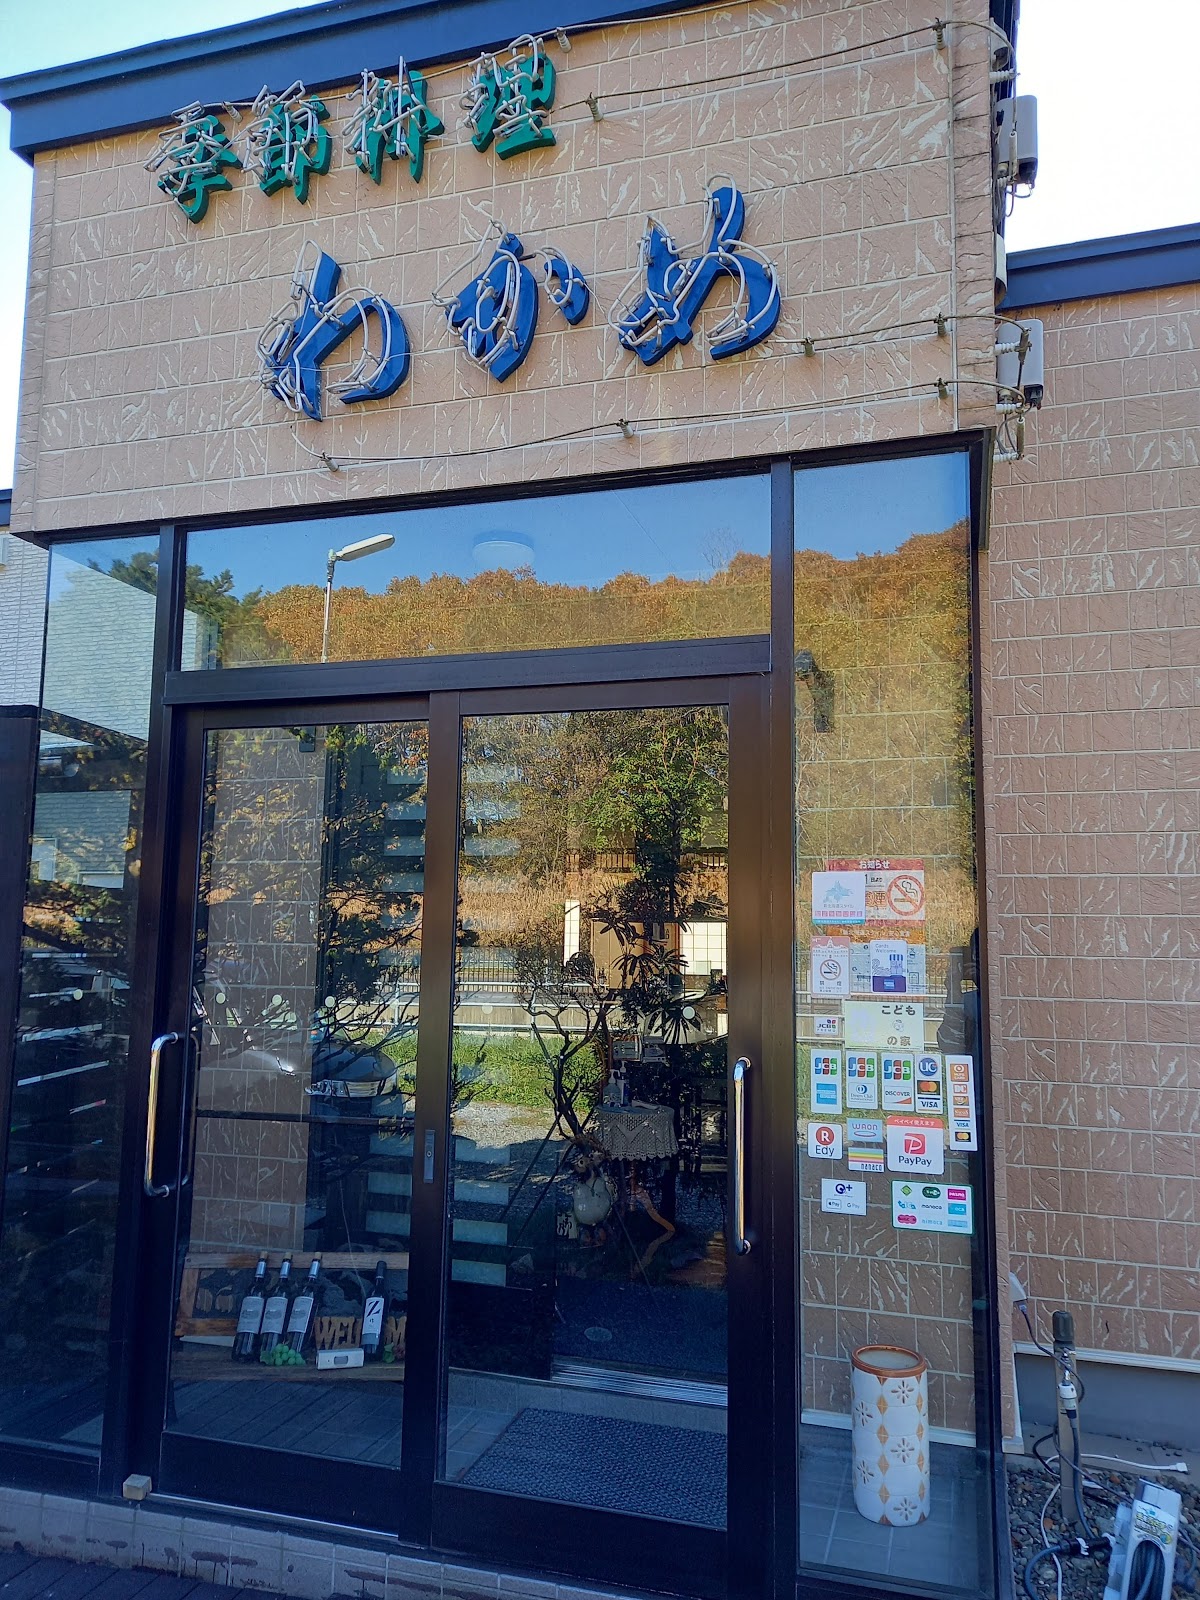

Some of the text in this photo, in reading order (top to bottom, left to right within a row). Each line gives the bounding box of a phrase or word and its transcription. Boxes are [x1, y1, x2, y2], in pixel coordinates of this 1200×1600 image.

[859, 859, 890, 869] お知らせ
[881, 1005, 916, 1016] こども
[887, 1035, 911, 1047] の家
[920, 1062, 937, 1073] UC
[921, 1101, 938, 1109] VISA
[815, 1145, 835, 1157] Edy
[898, 1155, 932, 1167] PayPay
